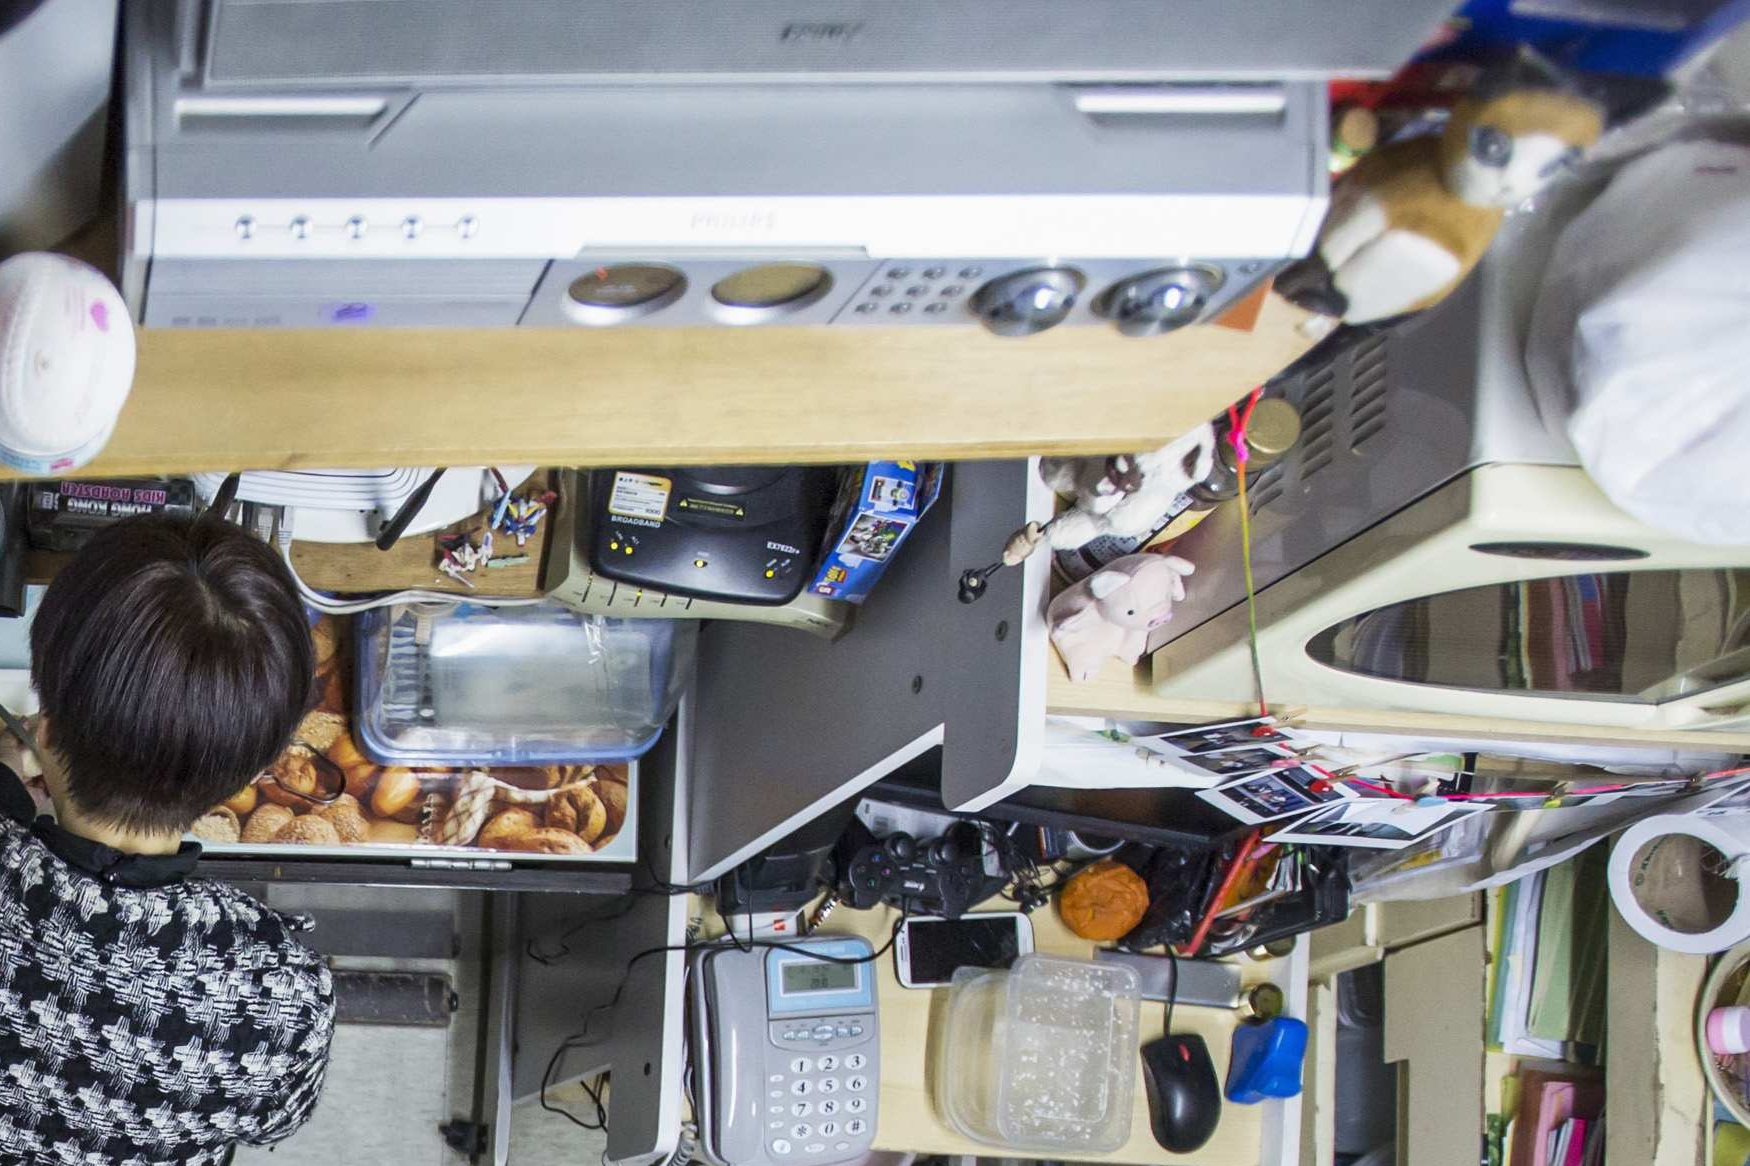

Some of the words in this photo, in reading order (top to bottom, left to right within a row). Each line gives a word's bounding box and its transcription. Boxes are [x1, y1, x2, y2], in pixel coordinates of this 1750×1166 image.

[60, 482, 131, 502] ROADSTER
[133, 489, 167, 505] KIDS
[66, 497, 108, 516] KONG
[611, 514, 661, 528] BROADBAND
